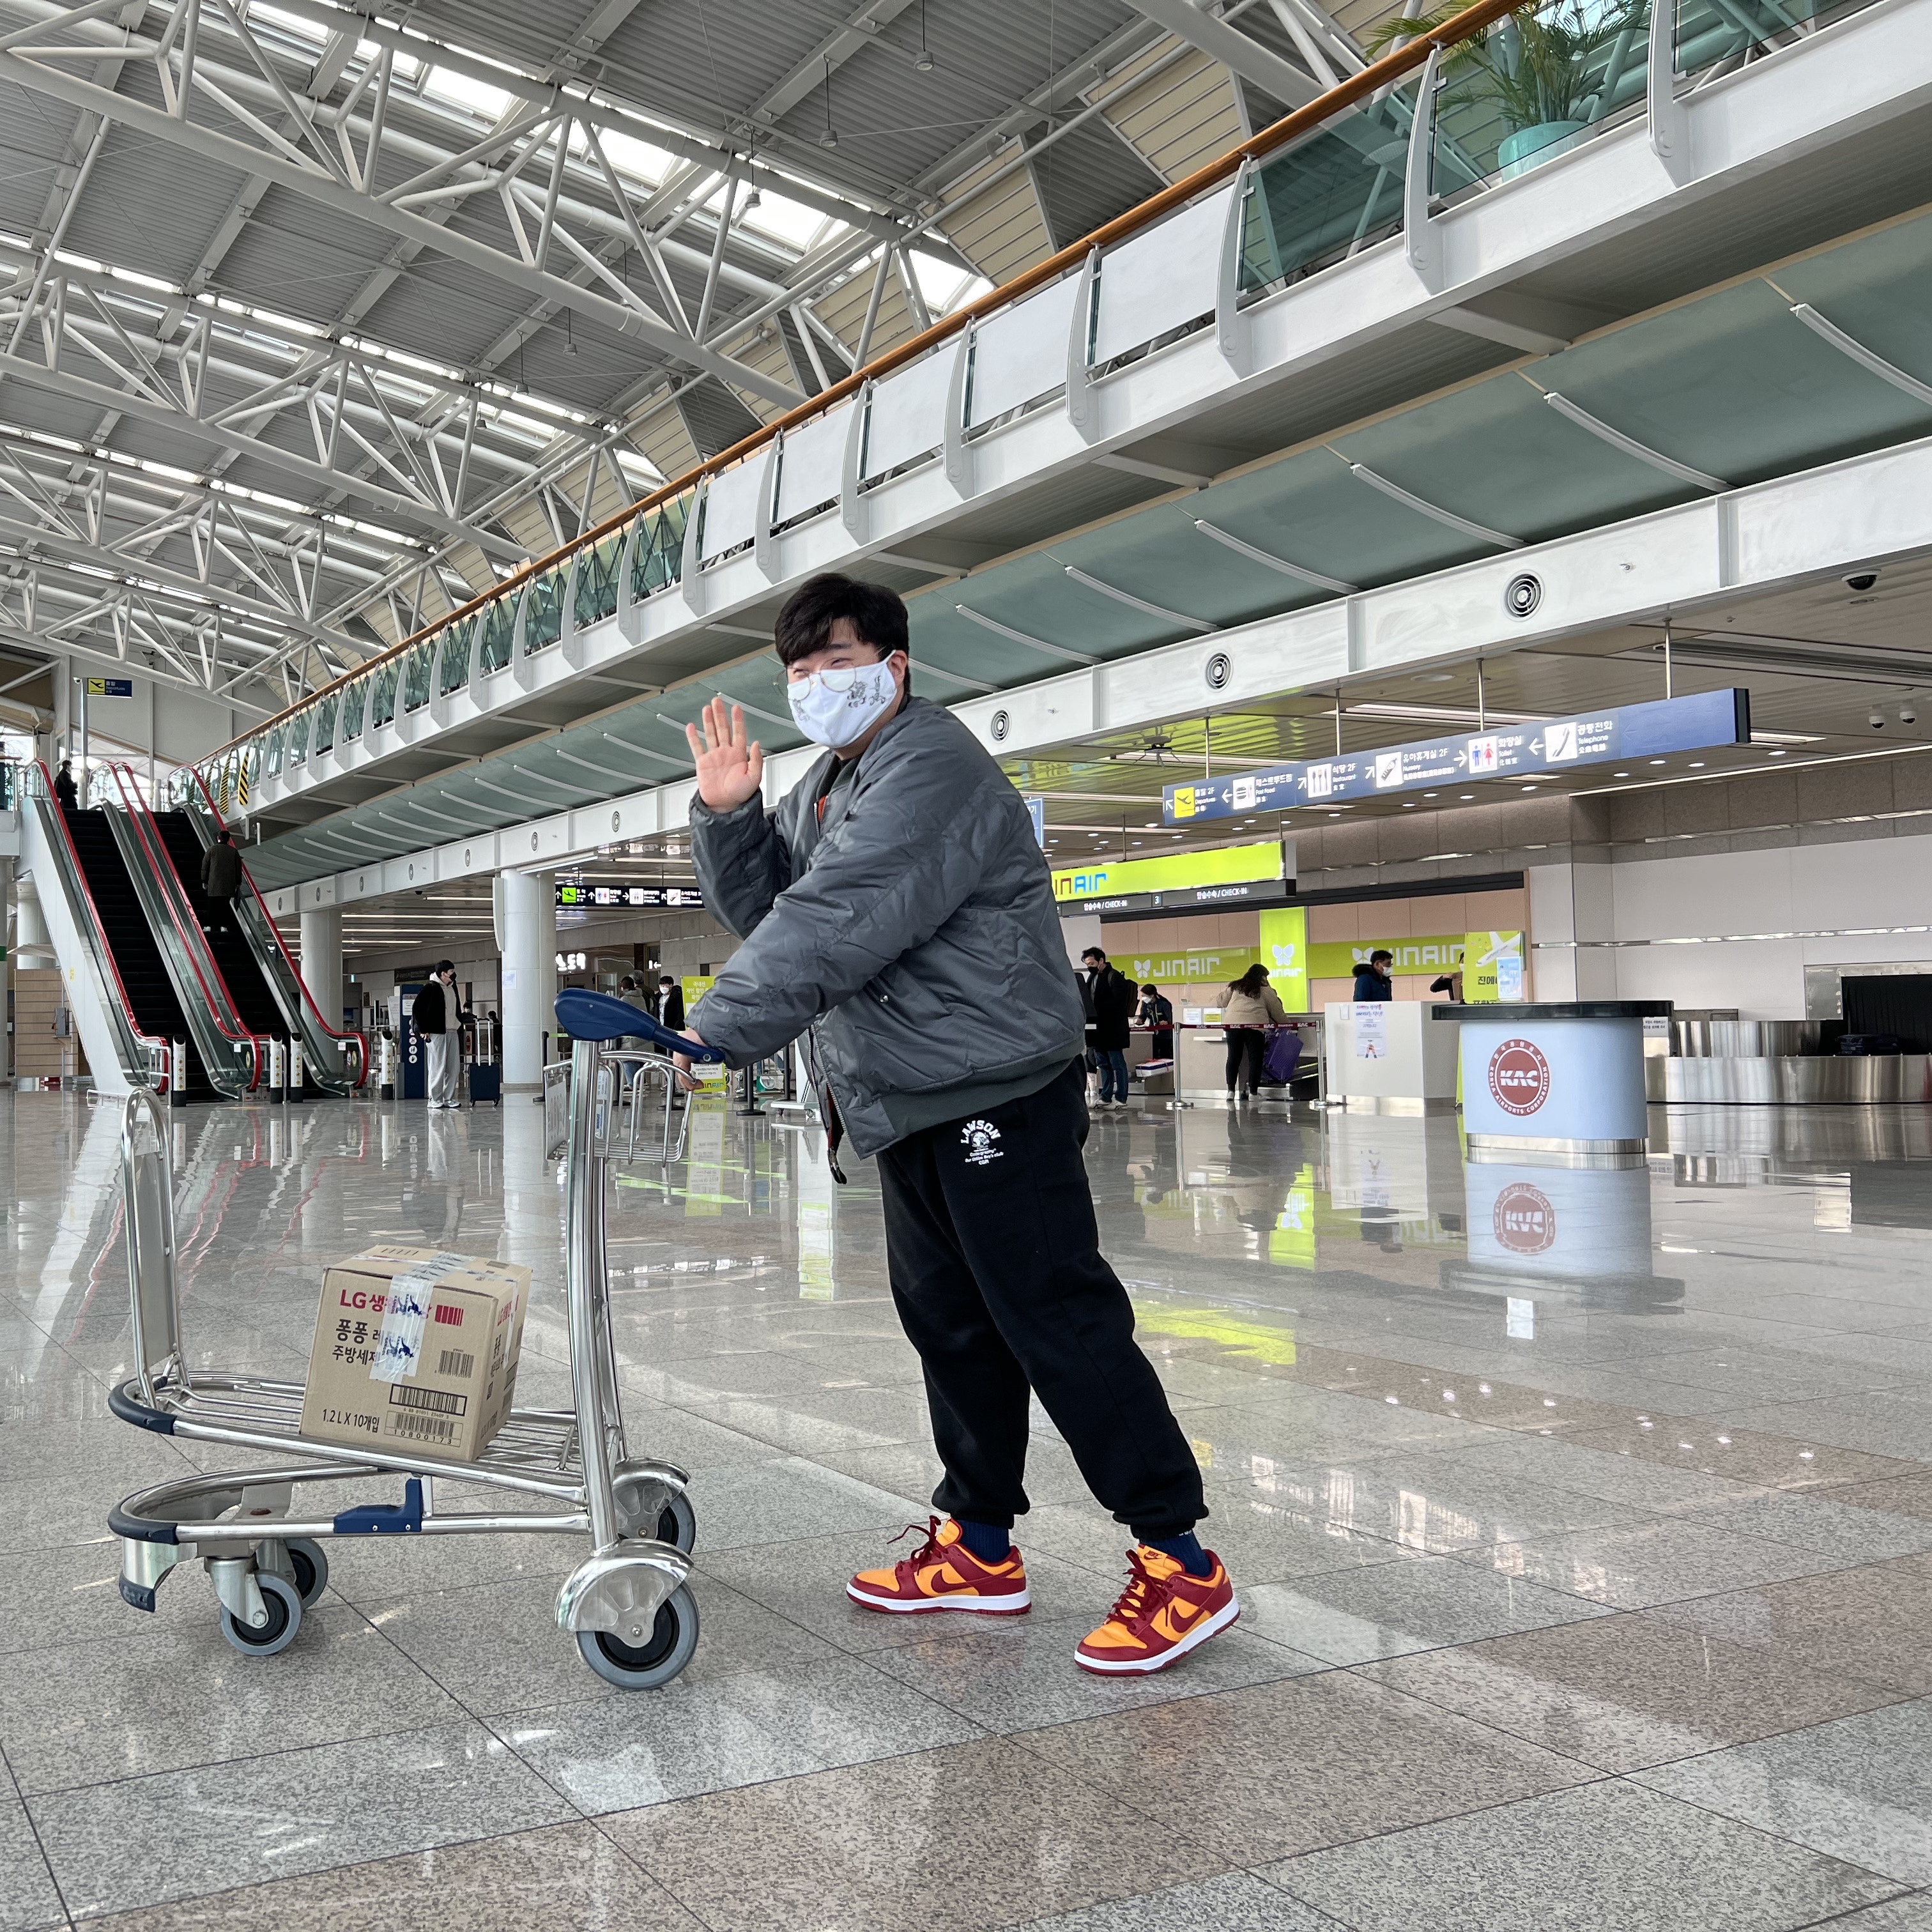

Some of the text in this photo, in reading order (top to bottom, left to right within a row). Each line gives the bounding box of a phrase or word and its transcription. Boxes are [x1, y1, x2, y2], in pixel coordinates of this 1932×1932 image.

[1498, 735, 1522, 747] 화장실
[1578, 735, 1609, 744] Telephone
[1403, 747, 1448, 763] 유아휴게실 2F
[1332, 762, 1356, 774] 식당 2F
[1208, 786, 1215, 795] 2F
[1055, 873, 1107, 895] INAIR
[1221, 887, 1248, 897] CHECK-IN
[1154, 896, 1160, 905] 3
[1500, 1070, 1538, 1087] KAC
[1495, 1094, 1524, 1114] AIRPORTS
[1526, 1066, 1547, 1113] CORPORATION
[960, 1120, 1001, 1144] LAWSON
[335, 1318, 369, 1344] 퐁퐁
[353, 1413, 380, 1434] 10개입
